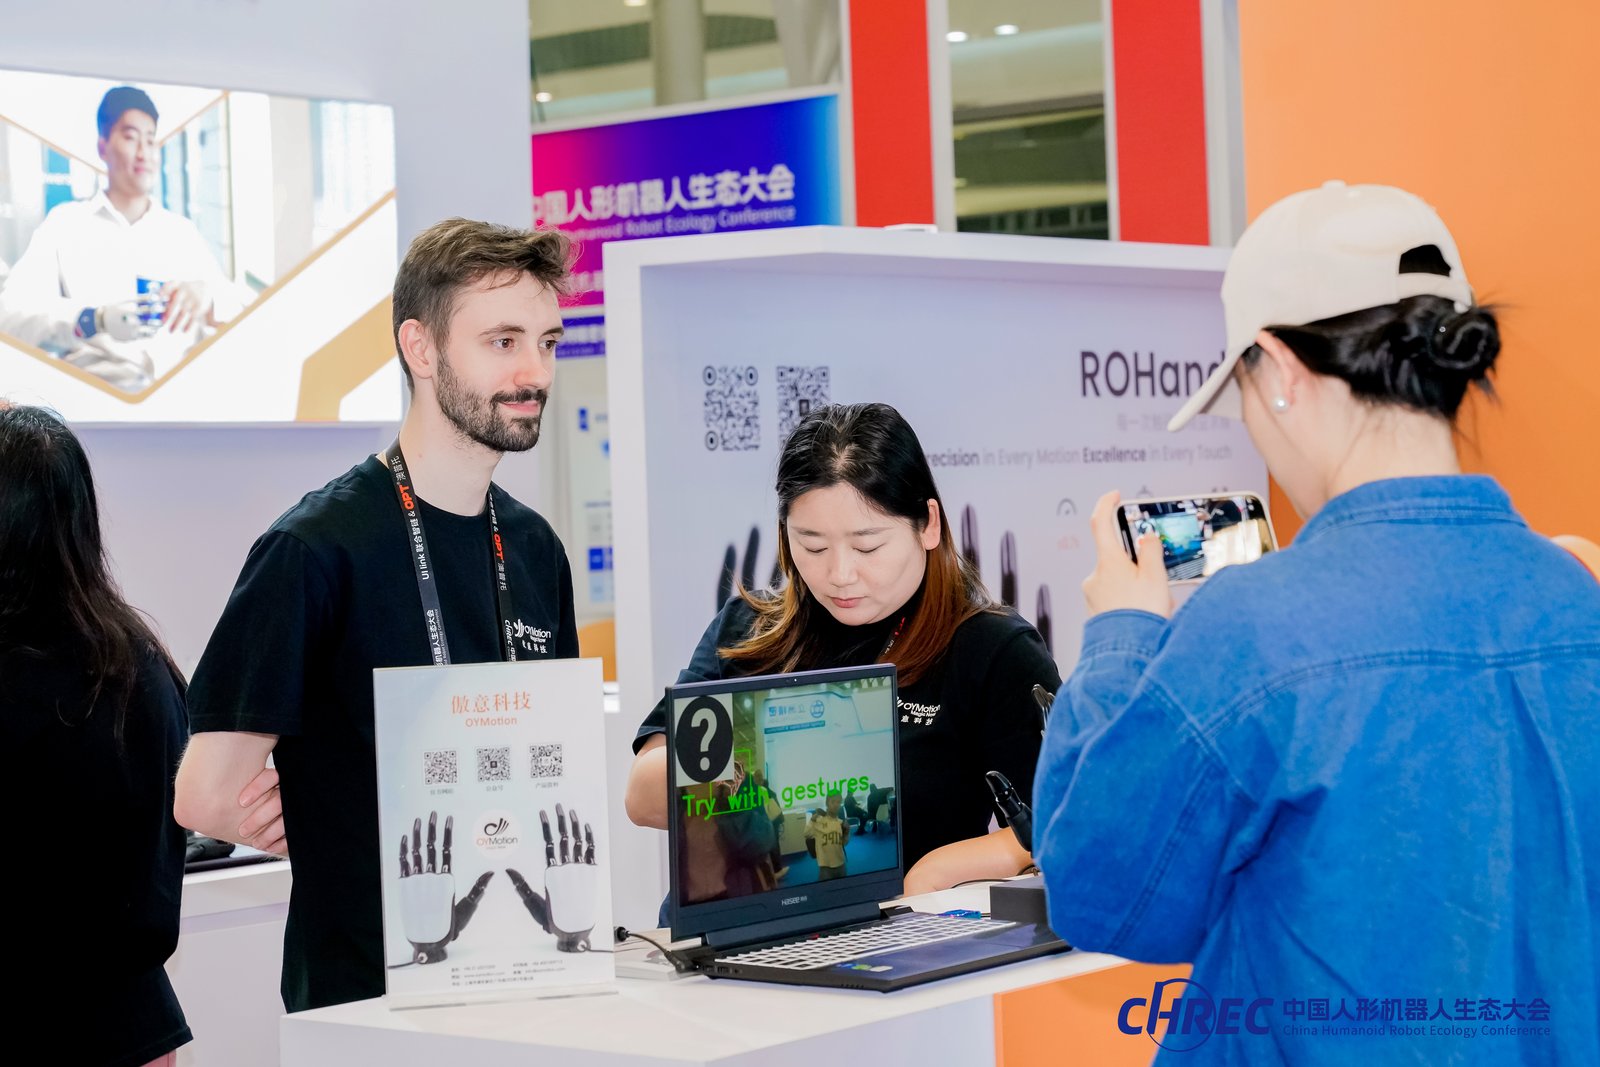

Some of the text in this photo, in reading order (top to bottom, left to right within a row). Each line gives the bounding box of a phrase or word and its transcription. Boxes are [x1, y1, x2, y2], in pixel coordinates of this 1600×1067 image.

[718, 205, 797, 227] Conference
[925, 450, 979, 467] recision
[1082, 447, 1147, 464] Excellence
[417, 553, 428, 570] link
[452, 691, 531, 715] 傲意科技
[465, 716, 518, 728] OYMotion
[682, 775, 870, 821] Try with gestures
[476, 837, 518, 847] OYMotion
